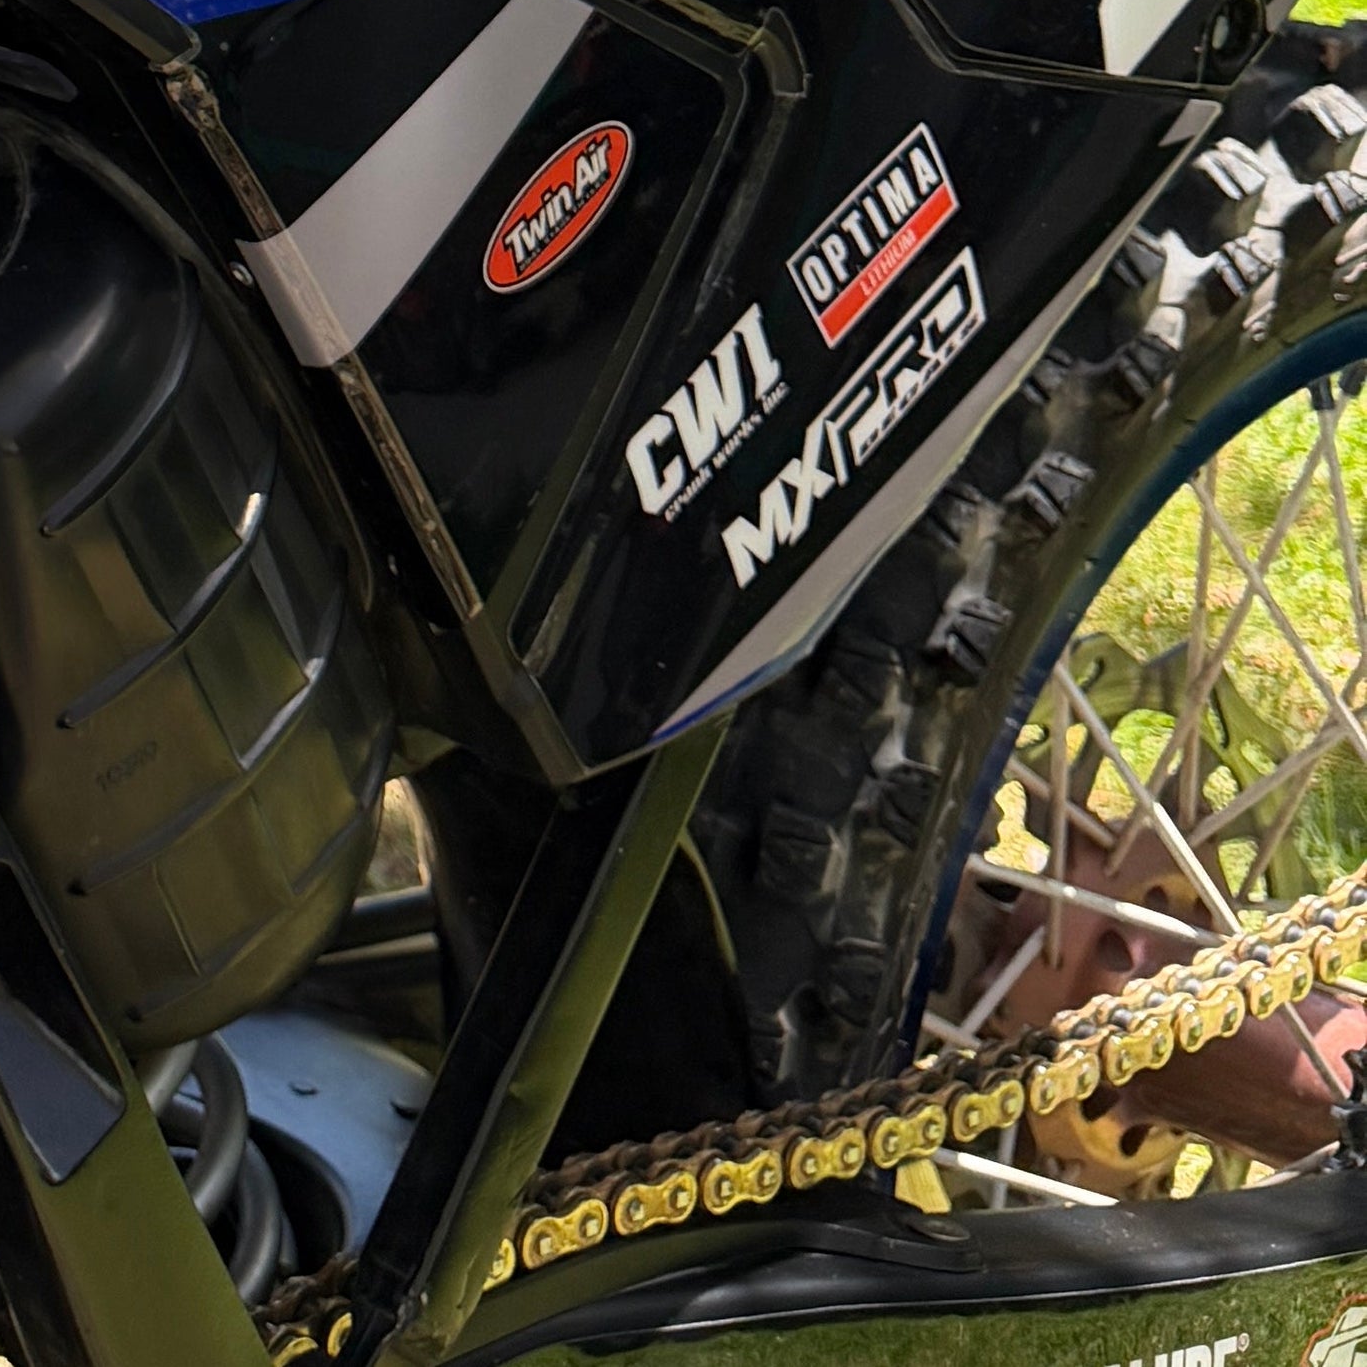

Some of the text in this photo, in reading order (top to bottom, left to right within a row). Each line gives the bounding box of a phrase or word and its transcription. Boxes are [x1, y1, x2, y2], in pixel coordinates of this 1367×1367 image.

[504, 184, 576, 265] Twin
[573, 136, 612, 202] Air
[801, 146, 940, 304] OPTIMA
[858, 229, 918, 298] LITHIUM
[625, 302, 782, 517] CWI
